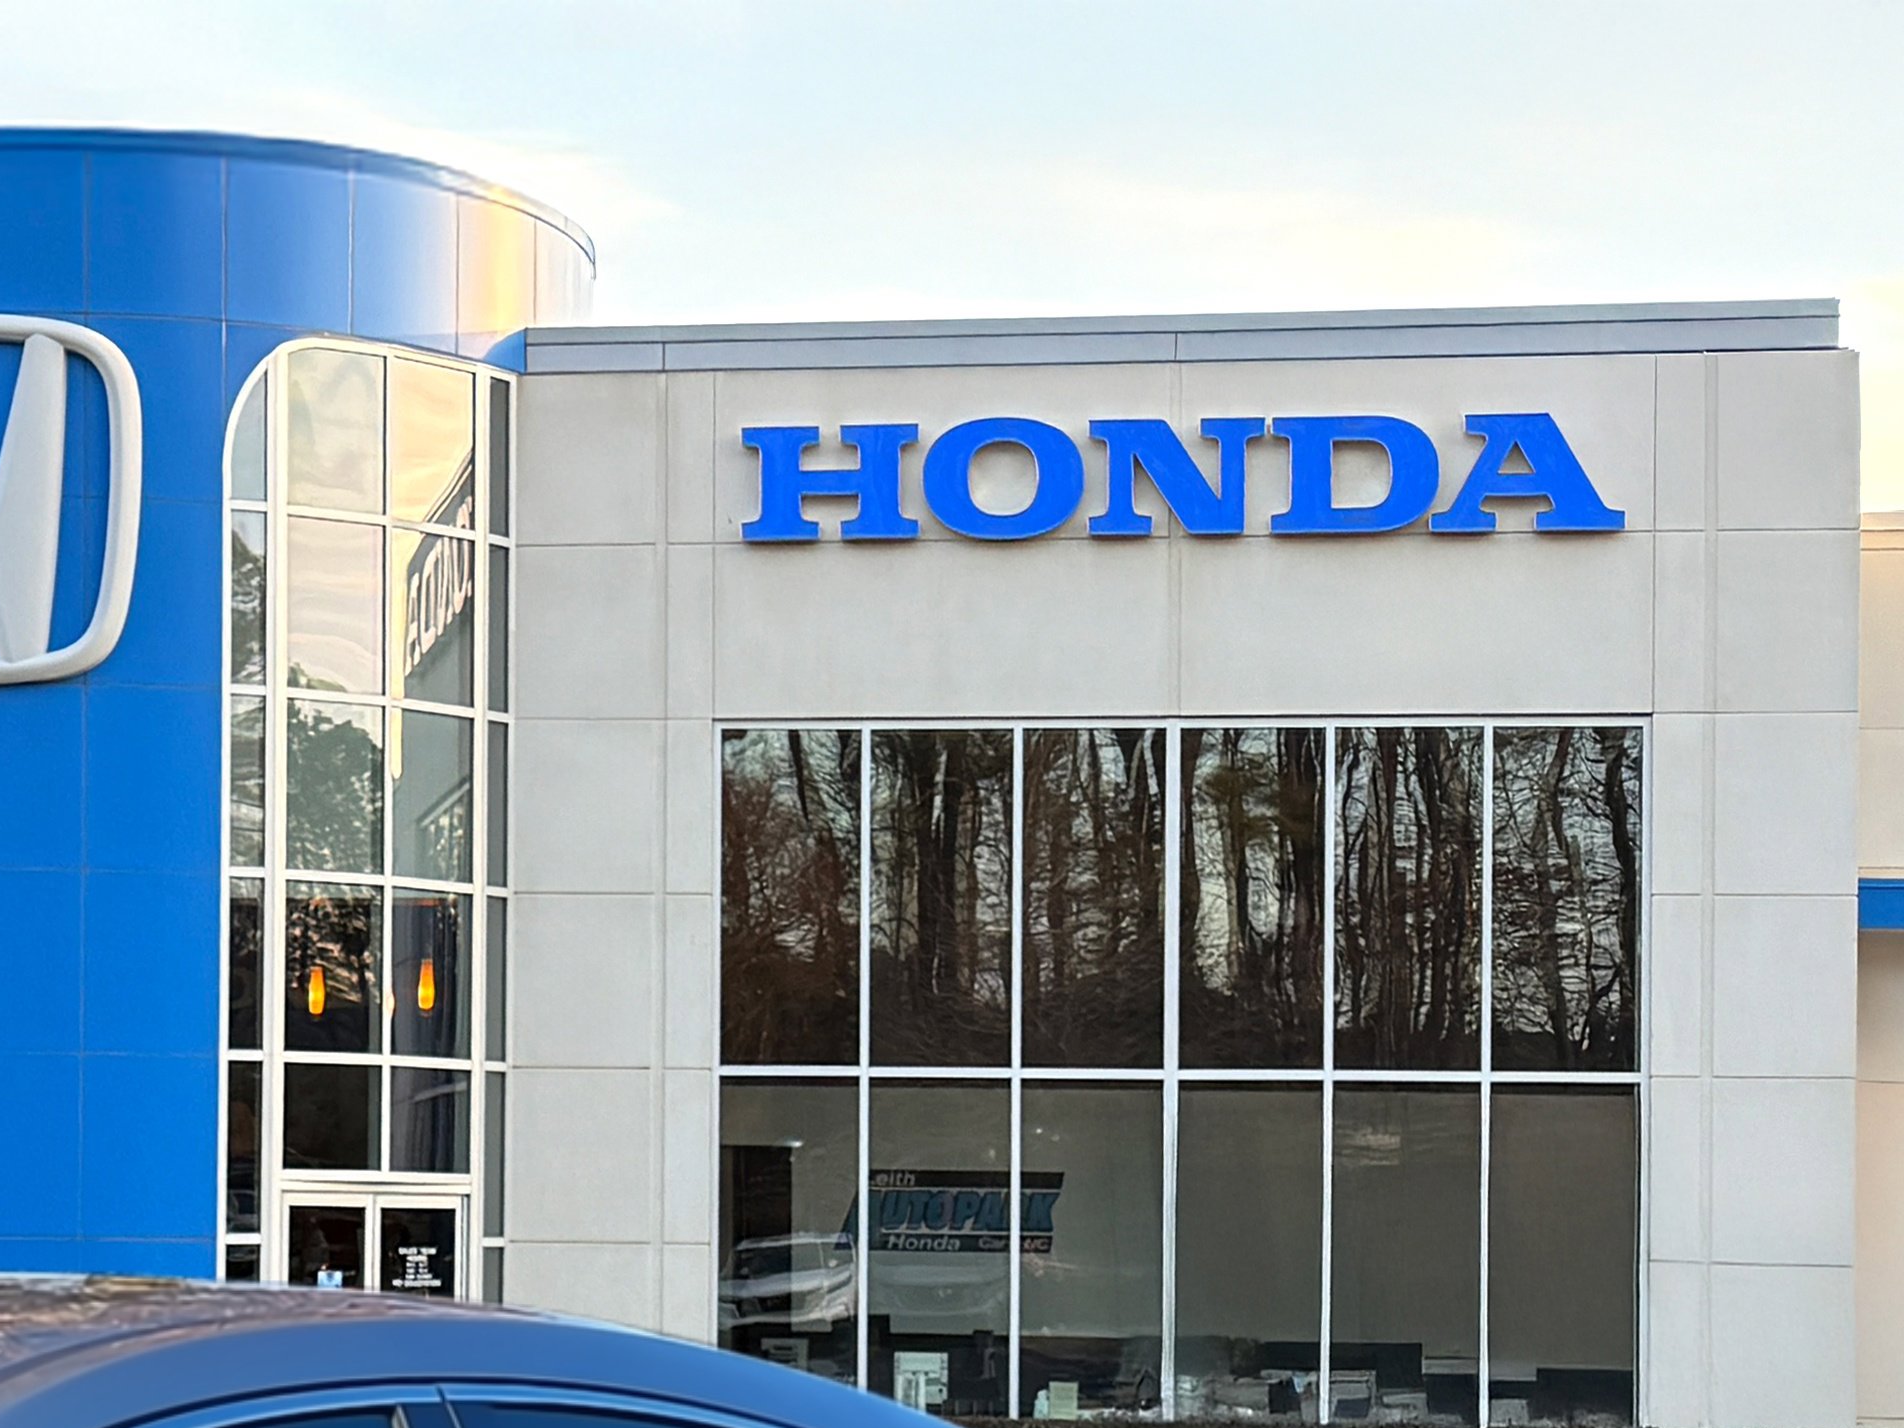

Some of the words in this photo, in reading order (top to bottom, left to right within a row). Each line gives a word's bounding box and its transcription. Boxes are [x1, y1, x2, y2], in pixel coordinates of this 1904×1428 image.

[741, 413, 1625, 542] HONDA
[869, 1171, 916, 1187] eith
[889, 1235, 961, 1251] Honda
[978, 1236, 1013, 1251] Car
